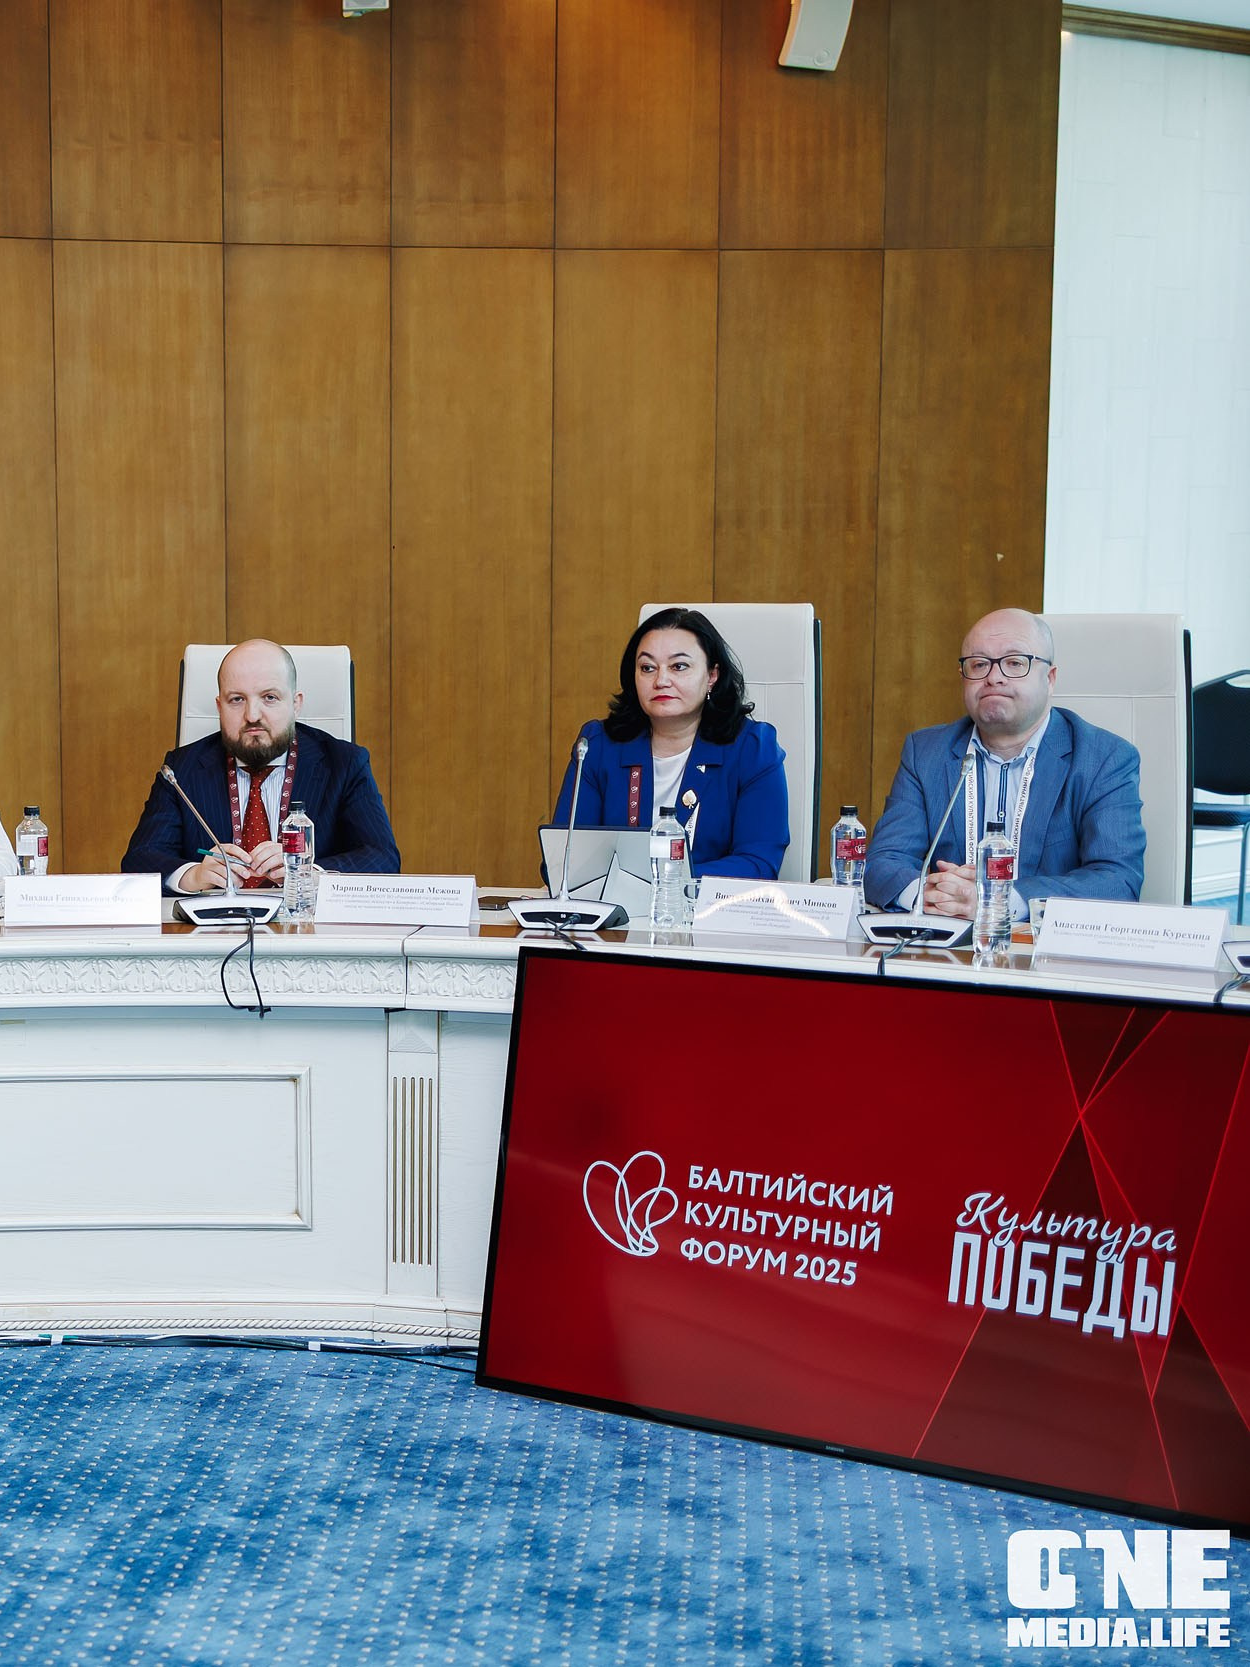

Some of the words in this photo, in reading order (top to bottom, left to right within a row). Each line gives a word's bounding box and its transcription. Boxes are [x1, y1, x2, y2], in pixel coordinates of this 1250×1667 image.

[332, 884, 364, 893] Марина
[366, 885, 425, 893] Вячеславовна
[428, 886, 461, 895] Межова
[803, 898, 837, 909] Минков
[1052, 919, 1101, 932] Анастасия
[1104, 923, 1160, 937] Георгиевна
[1162, 927, 1211, 941] Курехина
[686, 1164, 895, 1216] БАЛТИЙСКИЙ
[683, 1199, 882, 1253] КУЛЬТУРНЫЙ
[954, 1191, 1179, 1263] Культура
[679, 1236, 788, 1276] ФОРУМ
[793, 1255, 859, 1287] 2025
[947, 1231, 1178, 1340] ПОБЕДЫ
